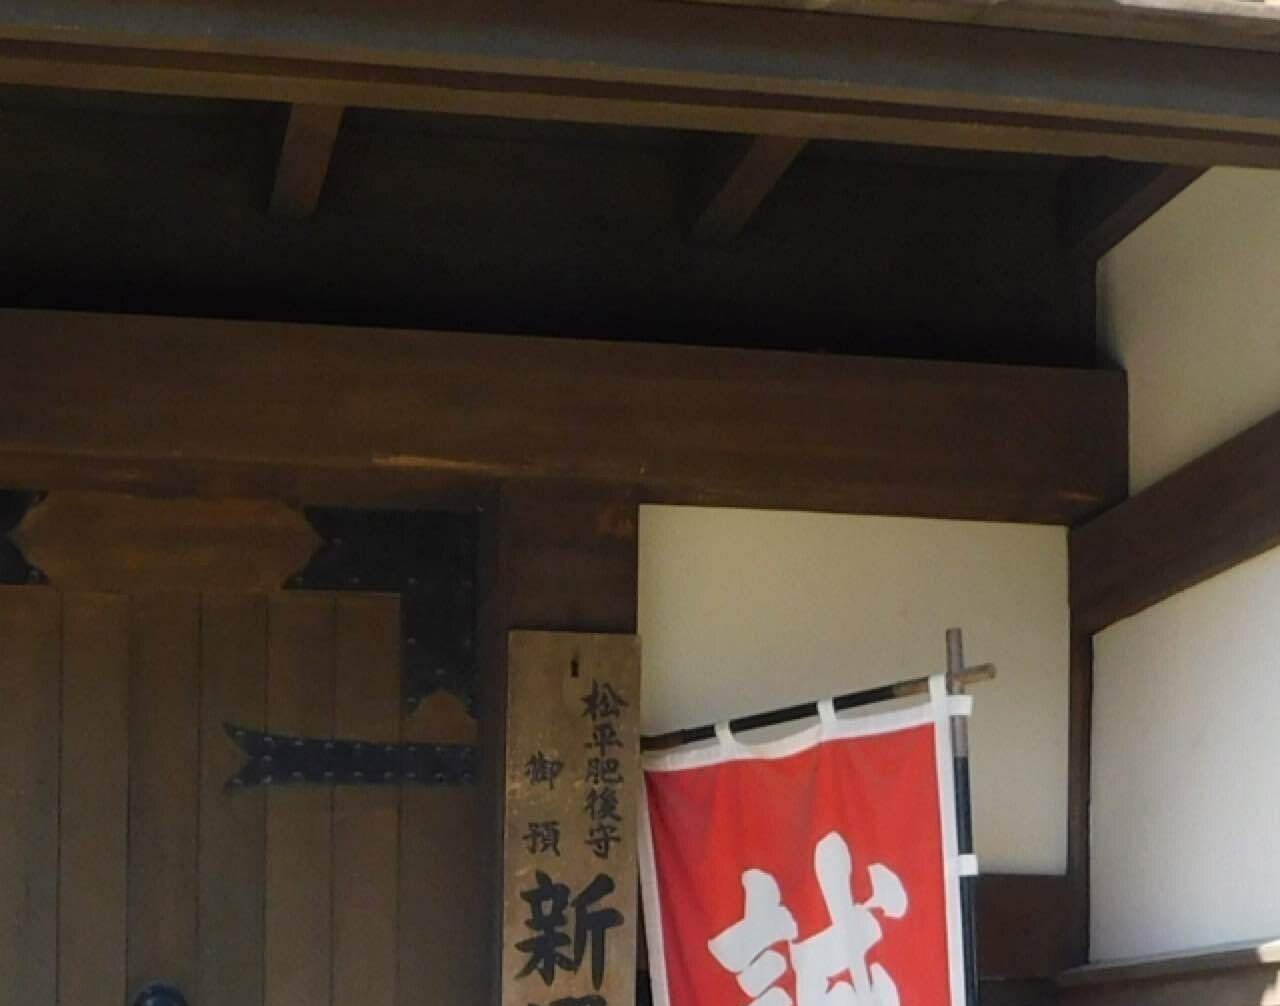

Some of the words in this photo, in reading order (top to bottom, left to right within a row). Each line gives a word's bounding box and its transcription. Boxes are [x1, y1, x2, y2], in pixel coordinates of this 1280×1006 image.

[581, 679, 629, 860] 松平肥後守
